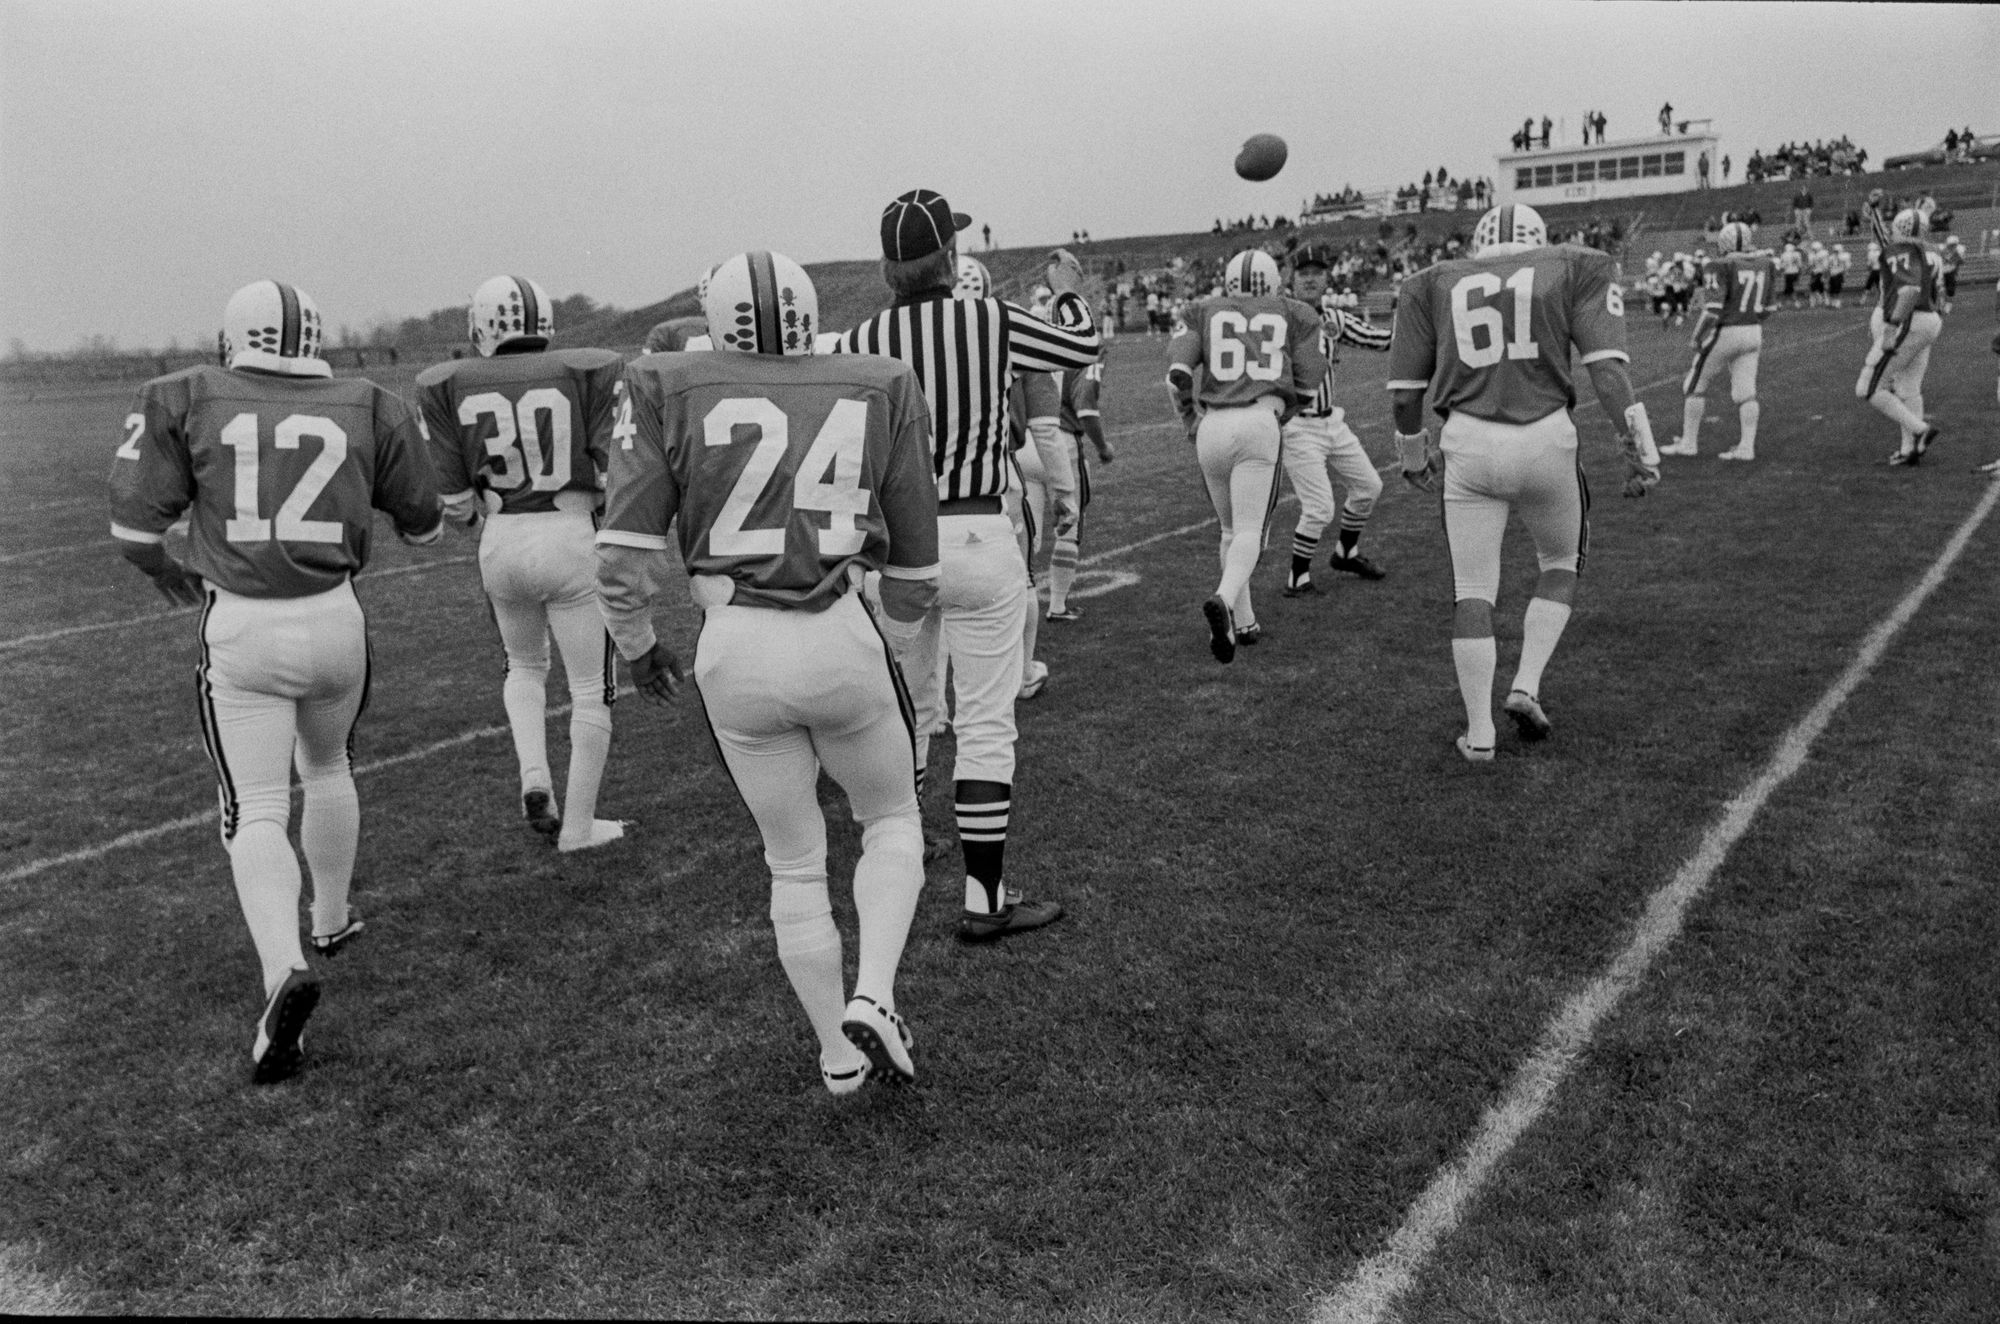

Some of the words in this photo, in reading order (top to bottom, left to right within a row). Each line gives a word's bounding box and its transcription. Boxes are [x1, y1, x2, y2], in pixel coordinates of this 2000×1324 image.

[1451, 267, 1538, 369] 61
[1737, 269, 1766, 313] 71
[1209, 310, 1288, 381] 63
[115, 411, 147, 461] 2
[219, 412, 348, 544] 12
[458, 388, 572, 491] 30
[703, 397, 871, 556] 24
